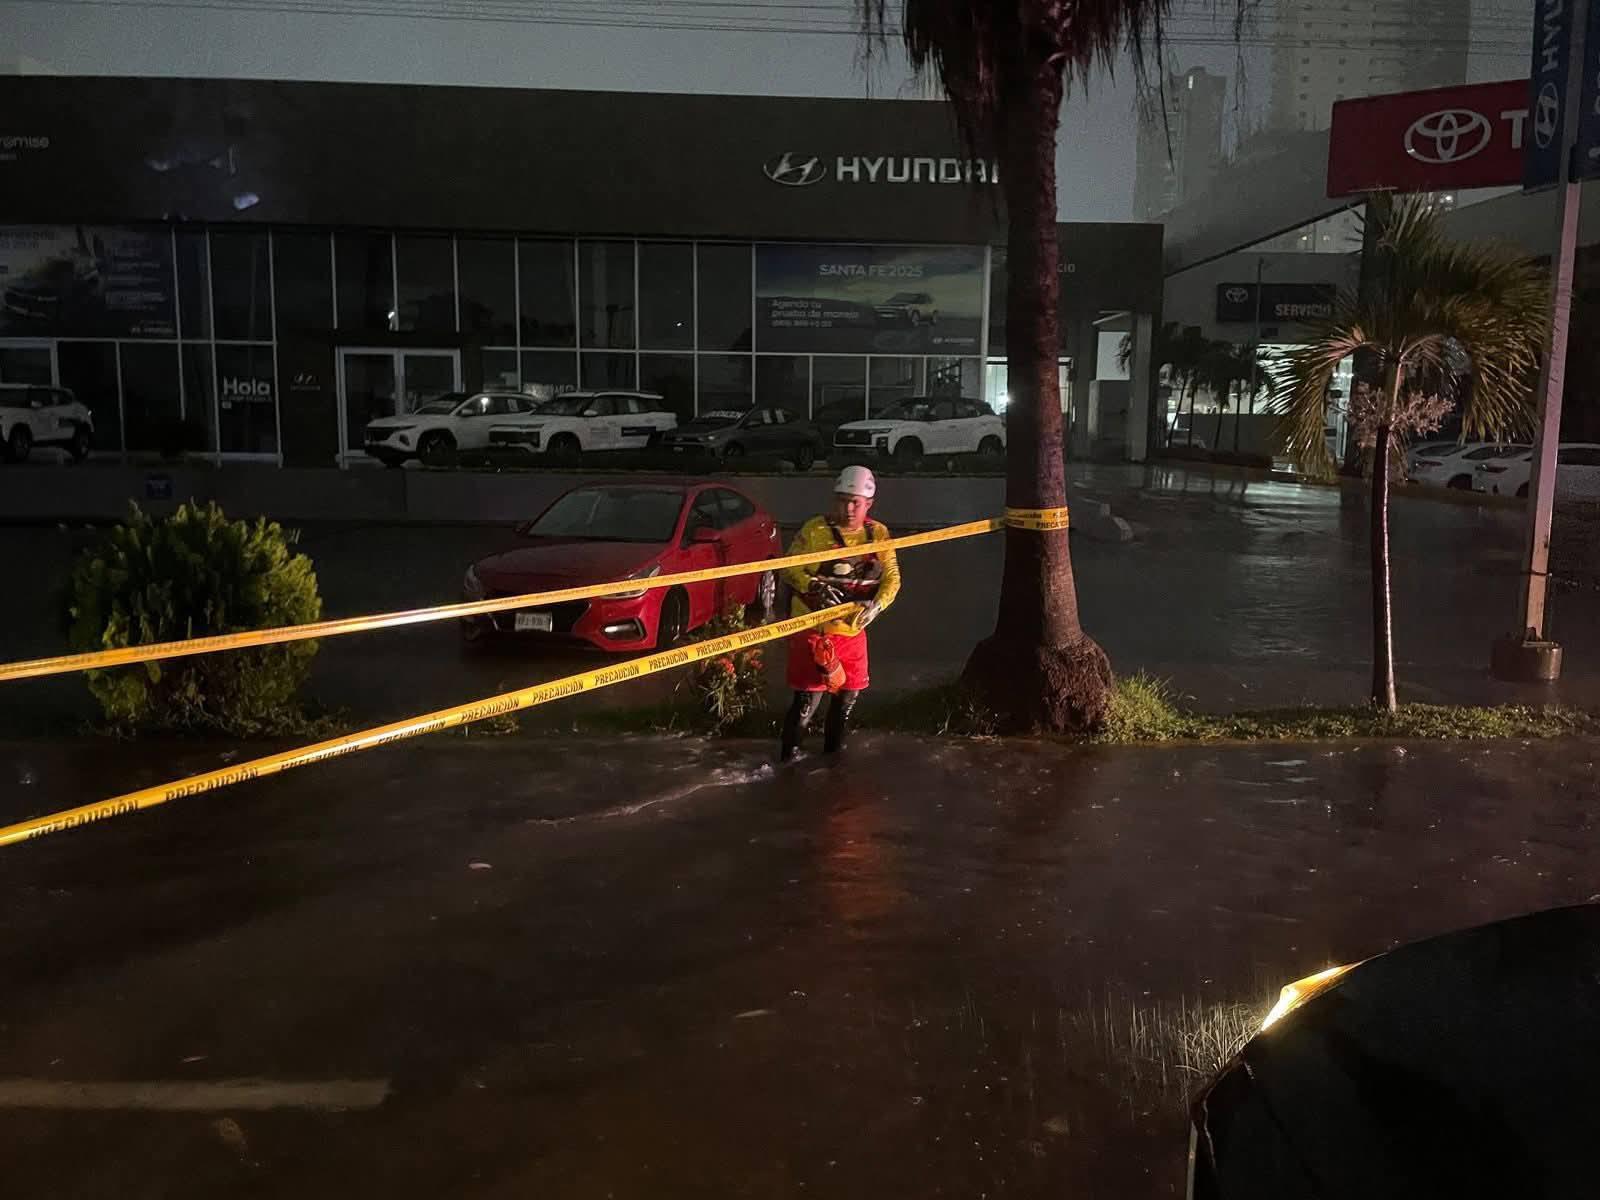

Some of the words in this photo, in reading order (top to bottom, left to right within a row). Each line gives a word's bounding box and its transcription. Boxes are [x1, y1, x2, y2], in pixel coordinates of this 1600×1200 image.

[836, 156, 999, 184] HYUNDAI
[819, 264, 866, 277] SANTA
[868, 264, 888, 277] FE
[223, 376, 271, 396] Hola
[461, 696, 520, 722] PRECAUCIÓN
[532, 679, 584, 703] PRECAUCIÓN
[595, 664, 640, 685] PRECAUCIÓN
[649, 650, 689, 671] PRECAUCIÓN
[697, 638, 733, 657] PRECAUCIÓN
[738, 628, 770, 646] PRECAUCIÓN
